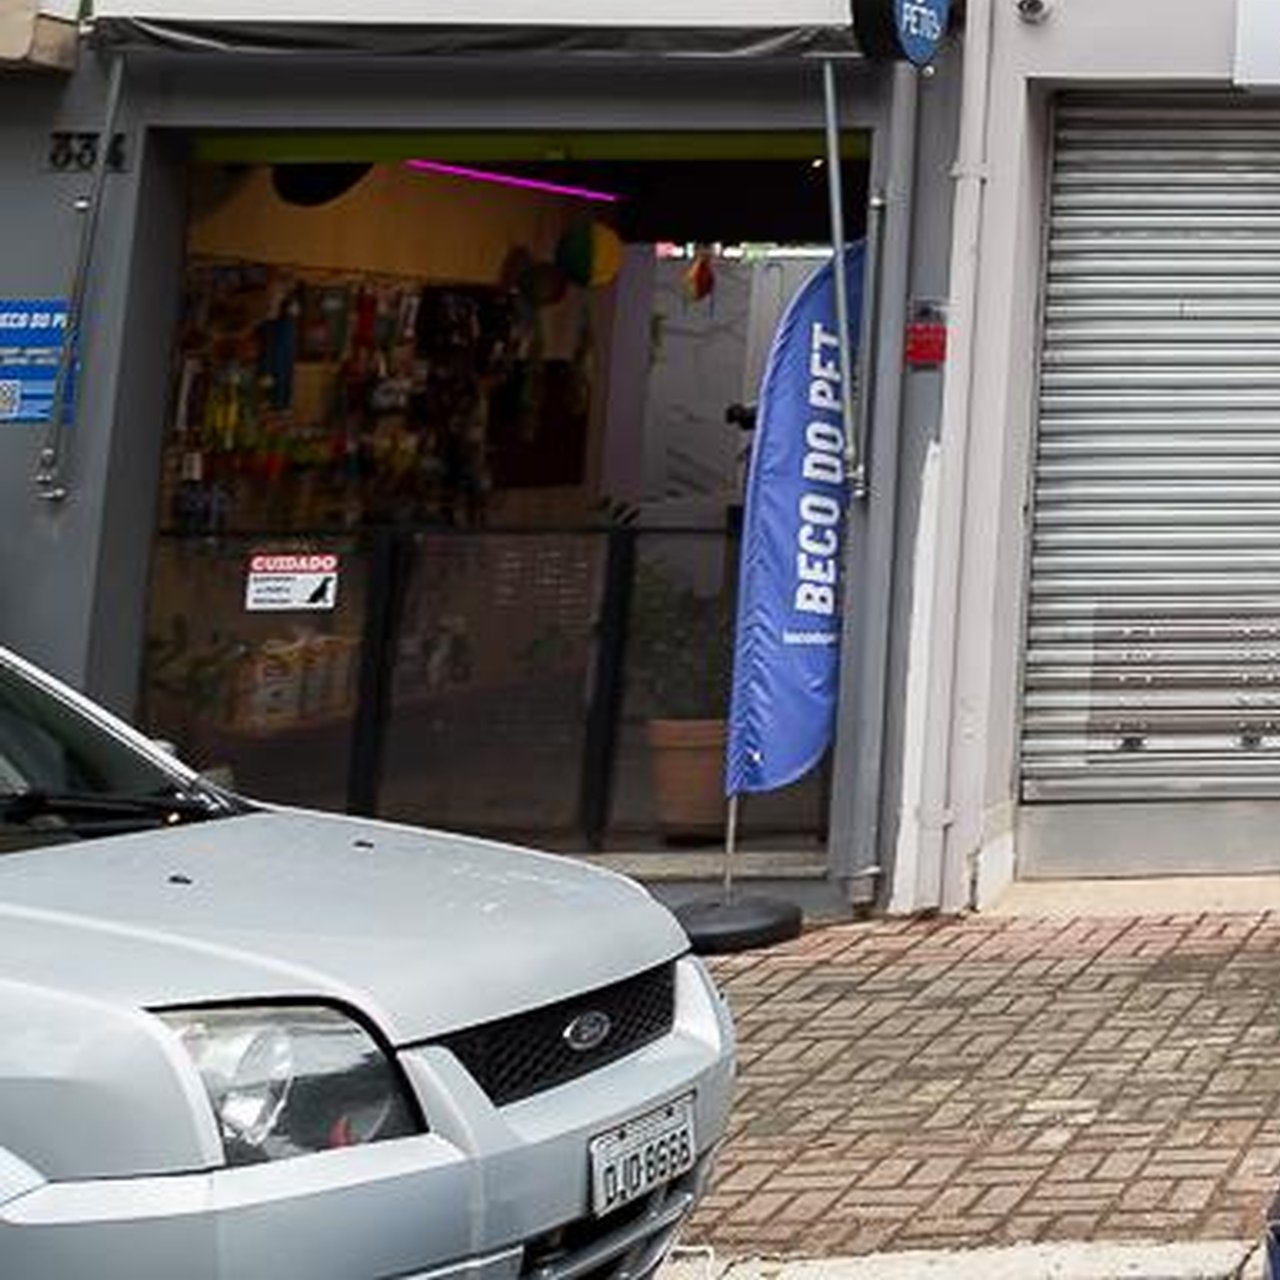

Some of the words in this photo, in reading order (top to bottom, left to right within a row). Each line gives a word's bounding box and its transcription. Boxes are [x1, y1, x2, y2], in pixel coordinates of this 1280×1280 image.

[802, 421, 844, 484] DO
[251, 555, 338, 572] CUIDADO
[794, 492, 841, 616] BECO
